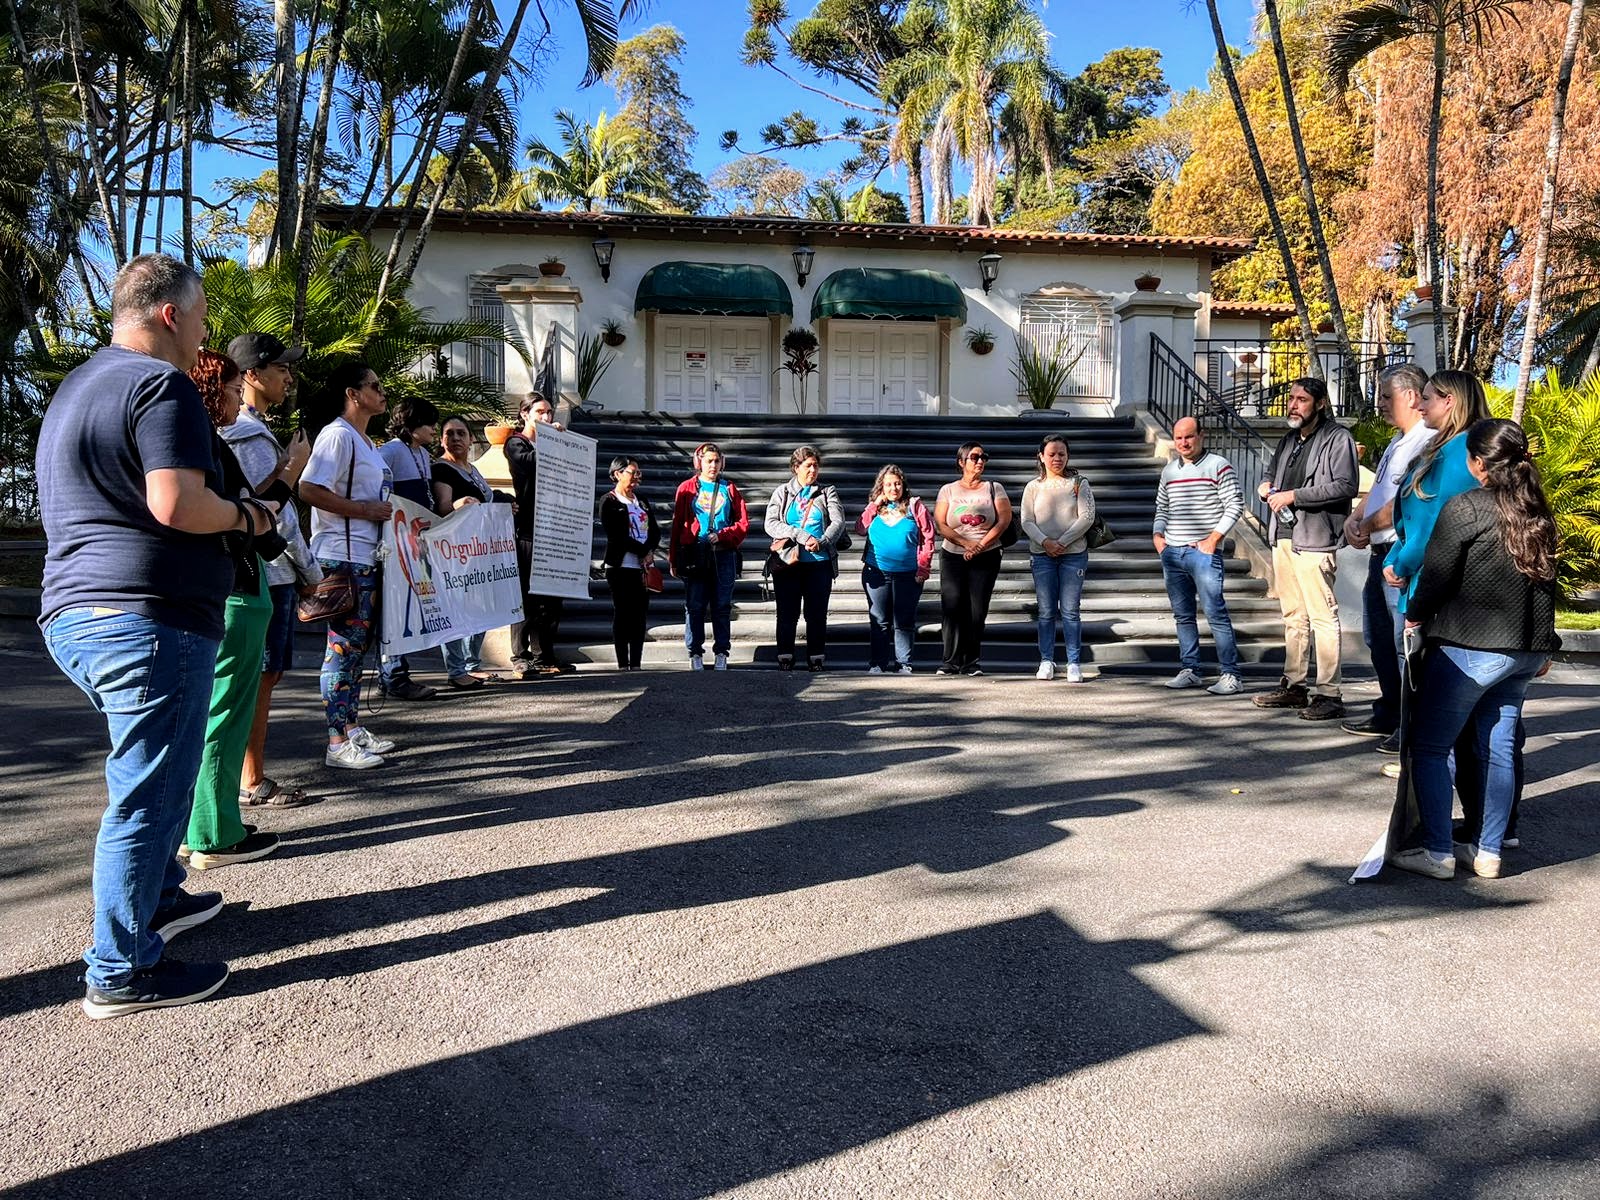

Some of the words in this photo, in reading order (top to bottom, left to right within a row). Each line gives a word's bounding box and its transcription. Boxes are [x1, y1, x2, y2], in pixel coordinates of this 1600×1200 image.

[434, 536, 488, 565] "Orgulho
[443, 568, 486, 593] Respeito
[487, 570, 492, 583] e
